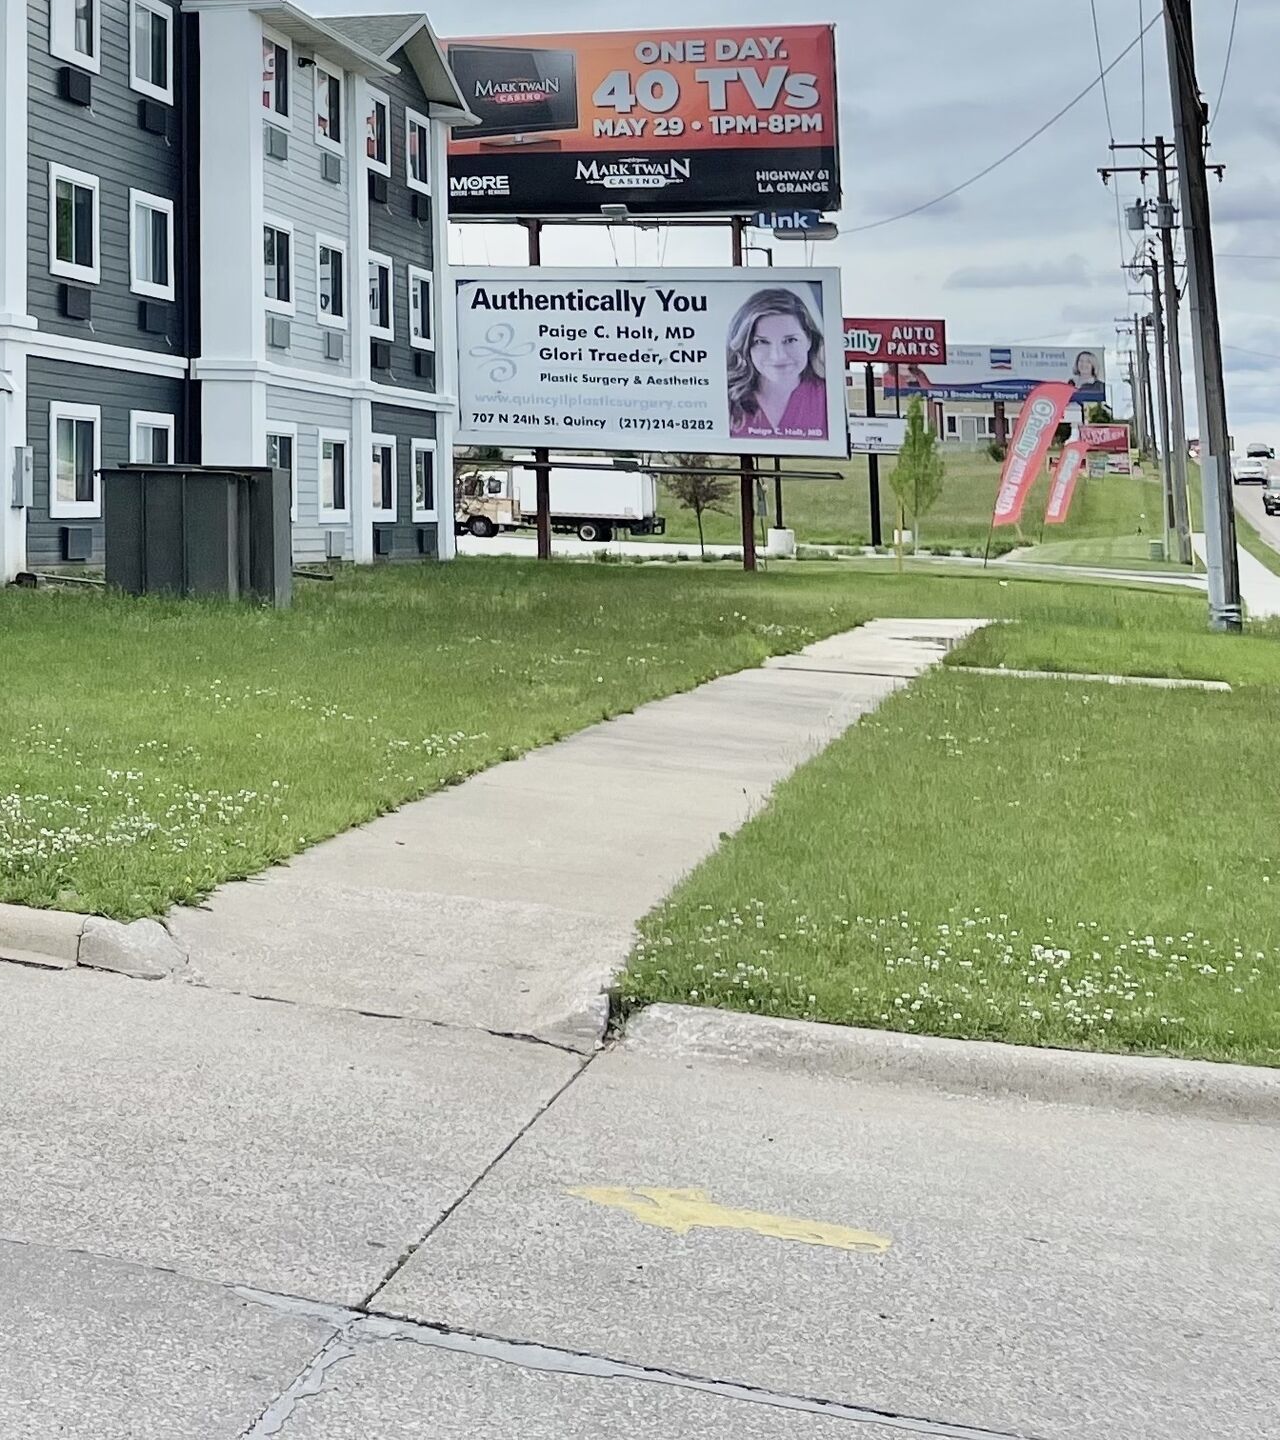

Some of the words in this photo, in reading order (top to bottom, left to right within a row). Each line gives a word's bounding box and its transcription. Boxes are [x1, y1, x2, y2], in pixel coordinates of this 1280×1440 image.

[635, 41, 705, 63] ONE
[715, 36, 788, 60] DAY.
[475, 80, 517, 96] MARK
[518, 78, 559, 93] TWAIN
[592, 69, 680, 113] 40
[695, 66, 820, 110] TVs
[499, 93, 541, 102] CASINO
[593, 118, 647, 137] MAY
[653, 117, 684, 136] 29
[708, 113, 823, 134] 1PM-8PM
[574, 160, 630, 179] MARK
[632, 158, 690, 178] TWAIN
[756, 170, 815, 181] HIGHWAY
[817, 170, 830, 180] 61
[449, 175, 510, 190] MORE
[609, 177, 660, 185] CASINO
[757, 183, 774, 193] LA
[776, 182, 829, 193] GRANGE
[758, 211, 811, 229] Link
[470, 288, 646, 317] Authentically
[655, 289, 707, 312] You
[538, 324, 588, 341] Paige
[594, 326, 610, 338] C.
[616, 326, 659, 341] Holt,
[665, 327, 695, 339] MD
[892, 326, 935, 340] AUTO
[539, 348, 582, 361] Glori
[589, 348, 664, 364] Traeder,
[669, 350, 708, 363] CNP
[887, 342, 940, 356] PARTS
[540, 372, 578, 383] Plastic
[582, 373, 629, 387] Surgery
[633, 375, 642, 385] &
[646, 375, 710, 386] Aesthetics
[472, 413, 495, 423] 707
[498, 414, 509, 424] N
[512, 414, 540, 425] 24th
[544, 415, 559, 426] St.
[563, 415, 607, 429] Quincy
[619, 417, 714, 430] (217)214-8282
